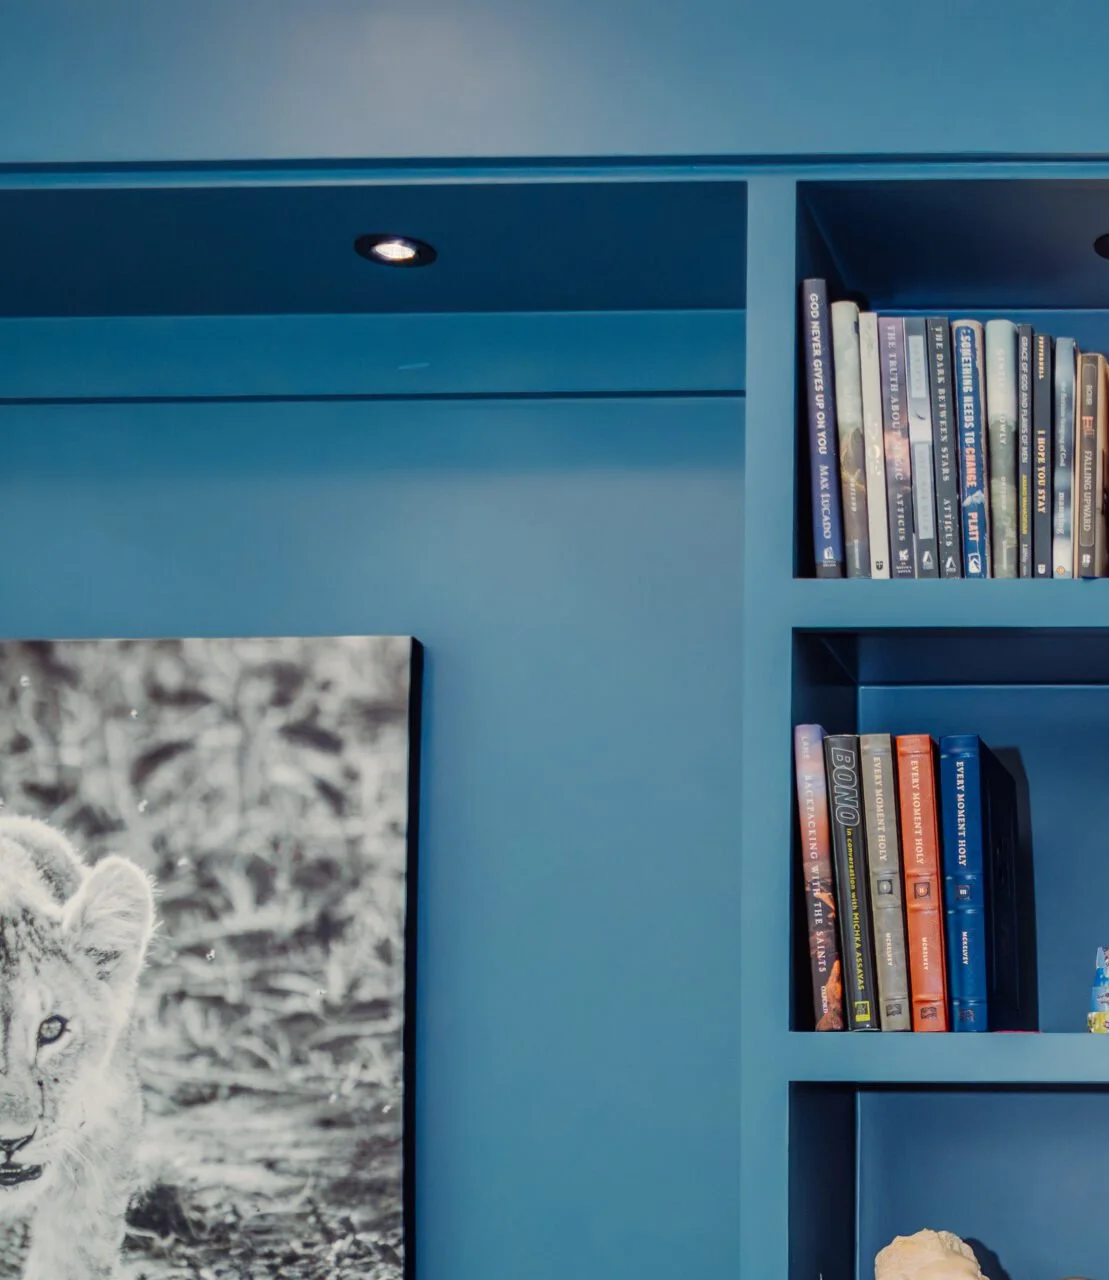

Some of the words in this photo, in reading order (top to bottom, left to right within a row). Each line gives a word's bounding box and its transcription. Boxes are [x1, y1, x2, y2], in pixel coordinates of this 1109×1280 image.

[809, 293, 819, 318] GOD
[811, 320, 822, 356] NEVER
[887, 325, 897, 349] THE
[934, 325, 944, 349] THE
[1021, 336, 1029, 362] GRACE
[814, 358, 824, 391] GIVES
[889, 352, 898, 390] TRUTH
[936, 353, 946, 384] DARK
[960, 335, 973, 393] SOMETHING
[1021, 362, 1029, 373] OF
[1021, 374, 1029, 391] GOD
[816, 393, 825, 409] UP
[891, 394, 901, 436] ABOUT
[963, 396, 975, 429] NEEDS
[1021, 391, 1029, 409] AND
[817, 412, 826, 429] ON
[938, 388, 948, 443] BETWEEN
[1021, 410, 1029, 434] FLAWS
[817, 431, 828, 456] YOU
[965, 431, 975, 445] TO
[1021, 434, 1029, 446] OF
[1037, 437, 1046, 464] HOPE
[941, 447, 951, 483] STARS
[966, 447, 977, 488] CHANGE
[1021, 446, 1029, 464] MEN
[1083, 450, 1092, 490] FALLING
[820, 464, 830, 491] MAX
[1038, 466, 1046, 486] YOU
[1038, 488, 1046, 513] STAY
[1056, 492, 1065, 535] manning
[1083, 491, 1091, 532] UPWARD
[821, 493, 831, 540] LUCADO
[896, 492, 906, 542] ATTICUS
[943, 498, 953, 547] ATTICUS
[968, 512, 980, 541] PLATT
[873, 756, 883, 786] EVERY
[910, 760, 920, 790] EVERY
[956, 761, 965, 791] EVERY
[831, 747, 860, 826] BONO
[804, 774, 818, 860] BACKPACKING
[875, 789, 886, 833] MOMENT
[912, 792, 922, 836] MOMENT
[956, 793, 966, 837] MOMENT
[846, 828, 853, 836] in
[878, 834, 888, 862] HOLY
[915, 838, 924, 865] HOLY
[958, 839, 967, 867] HOLY
[847, 838, 856, 890] conversation
[811, 864, 821, 897] WITH
[813, 902, 823, 925] THE
[851, 892, 859, 910] with
[853, 912, 862, 949] MICHKA
[816, 931, 826, 973] SAINTS
[855, 951, 865, 991] ASSAYAS
